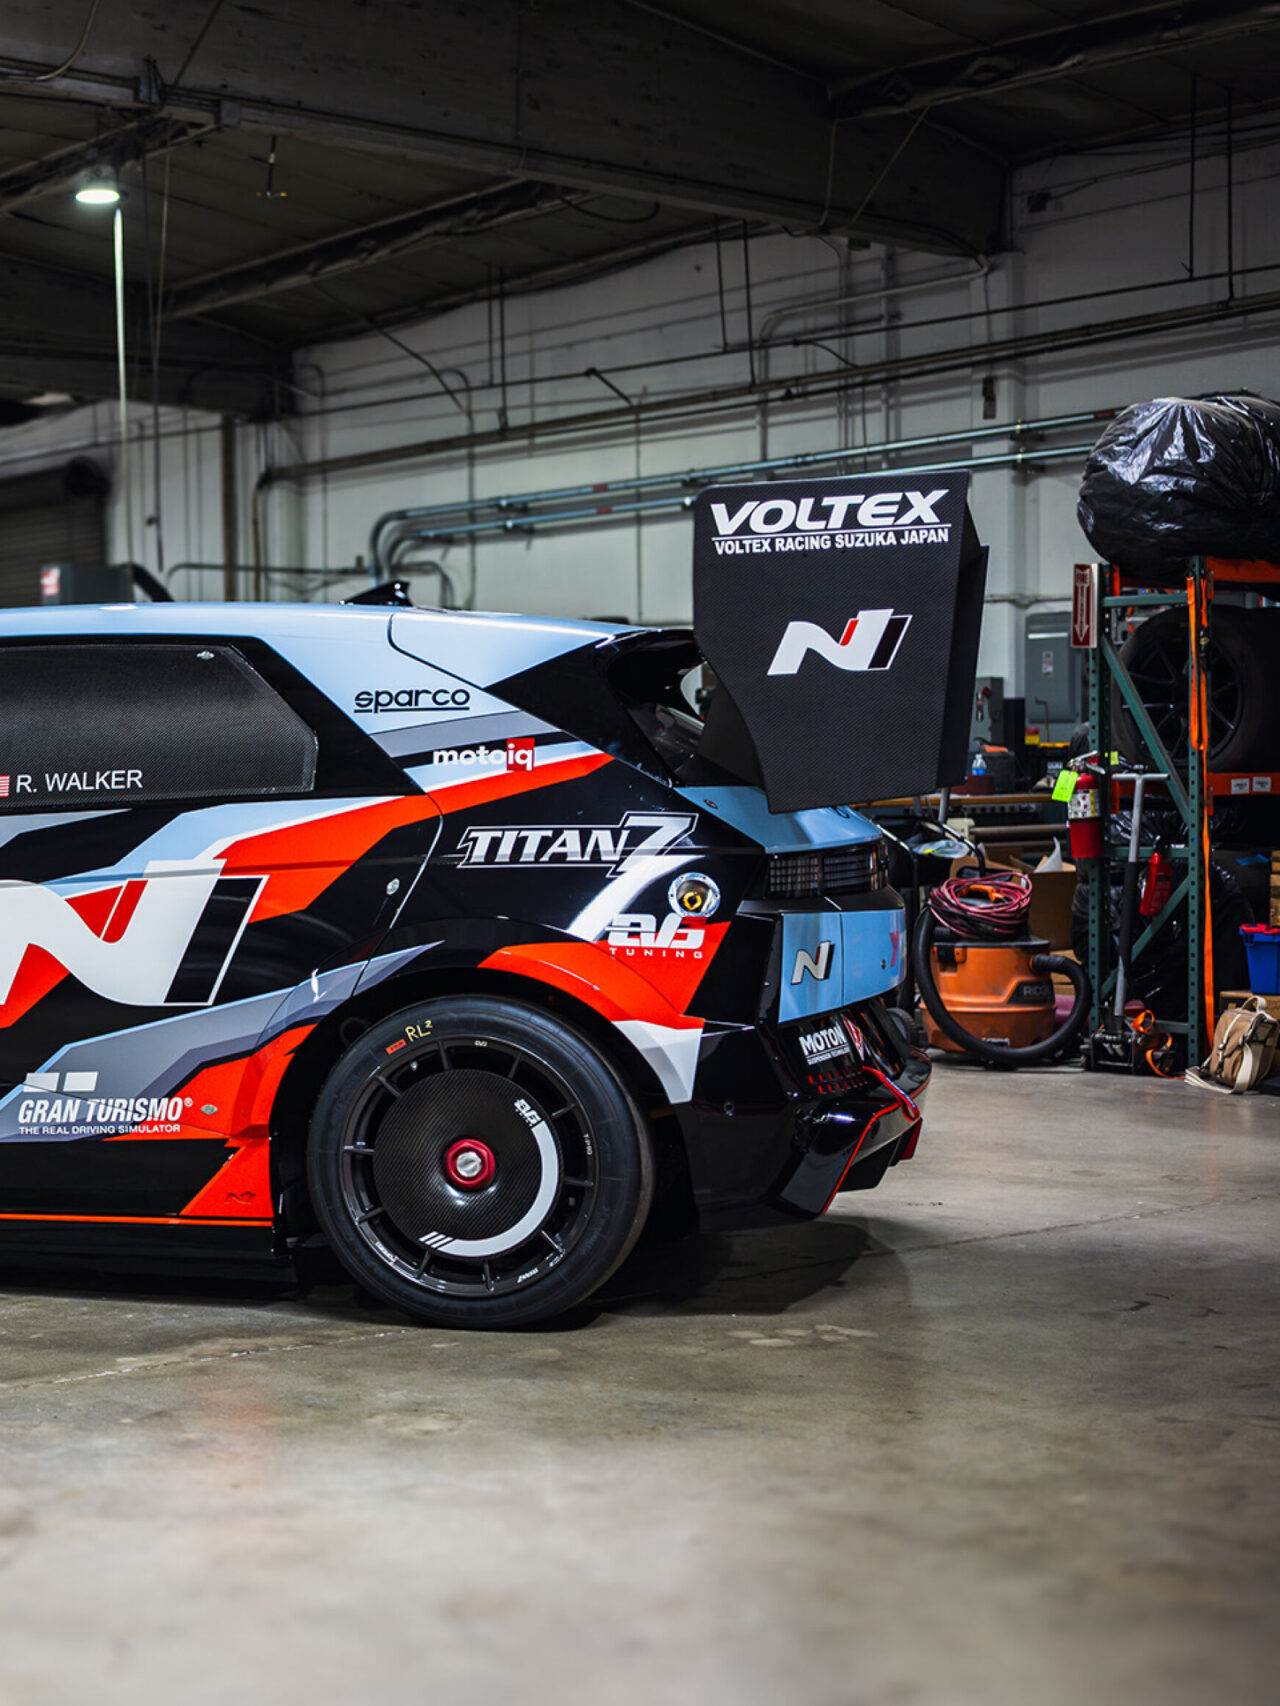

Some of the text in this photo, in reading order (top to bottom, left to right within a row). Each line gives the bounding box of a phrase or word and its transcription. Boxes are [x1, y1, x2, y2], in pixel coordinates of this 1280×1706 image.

[710, 489, 950, 536] VOLTEX
[715, 527, 949, 555] VOLTEX RACING SUZUKA JAPAN
[354, 689, 470, 713] sparco
[433, 743, 533, 771] motoiq
[16, 769, 143, 793] R. WALKER
[466, 815, 694, 873] TITAN7
[609, 947, 703, 959] TUNING
[799, 1024, 847, 1055] MOTON
[18, 1100, 81, 1124] GRAN
[19, 1124, 181, 1135] THE REAL DRIVING SIMULATOR
